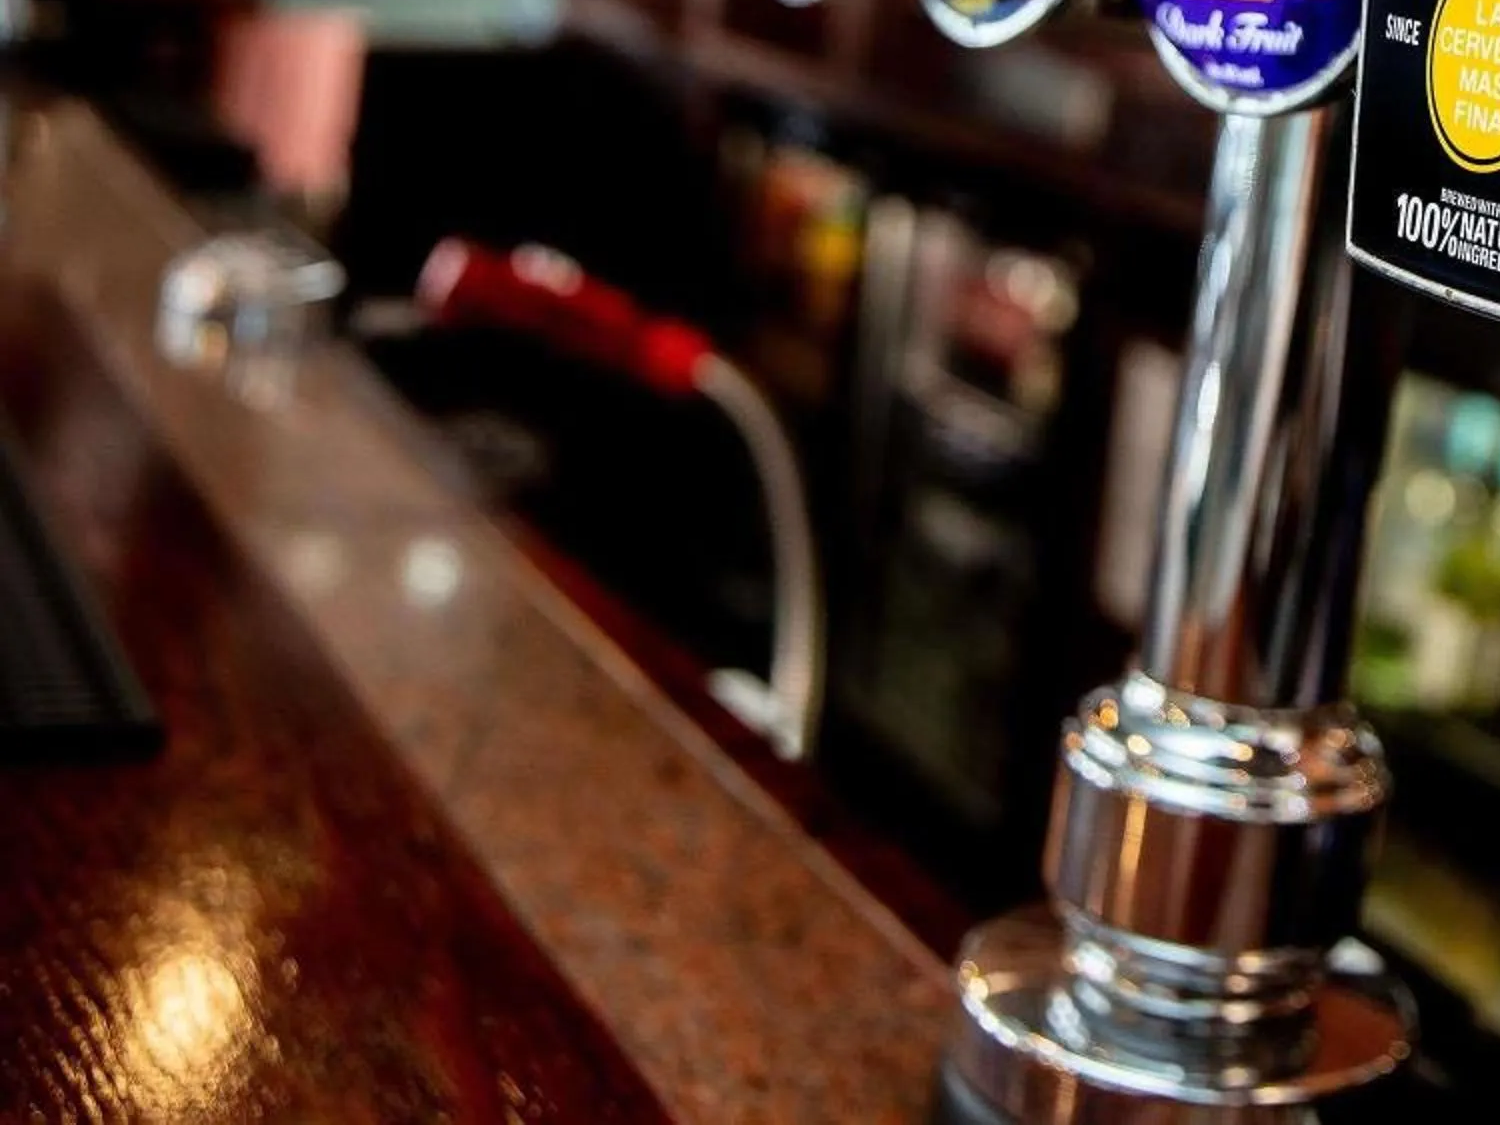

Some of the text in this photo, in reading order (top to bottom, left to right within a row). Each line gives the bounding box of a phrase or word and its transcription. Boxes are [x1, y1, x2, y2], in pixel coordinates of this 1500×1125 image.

[1385, 13, 1422, 46] SINCE
[1440, 187, 1477, 213] BREWED
[1397, 192, 1461, 258] 100%
